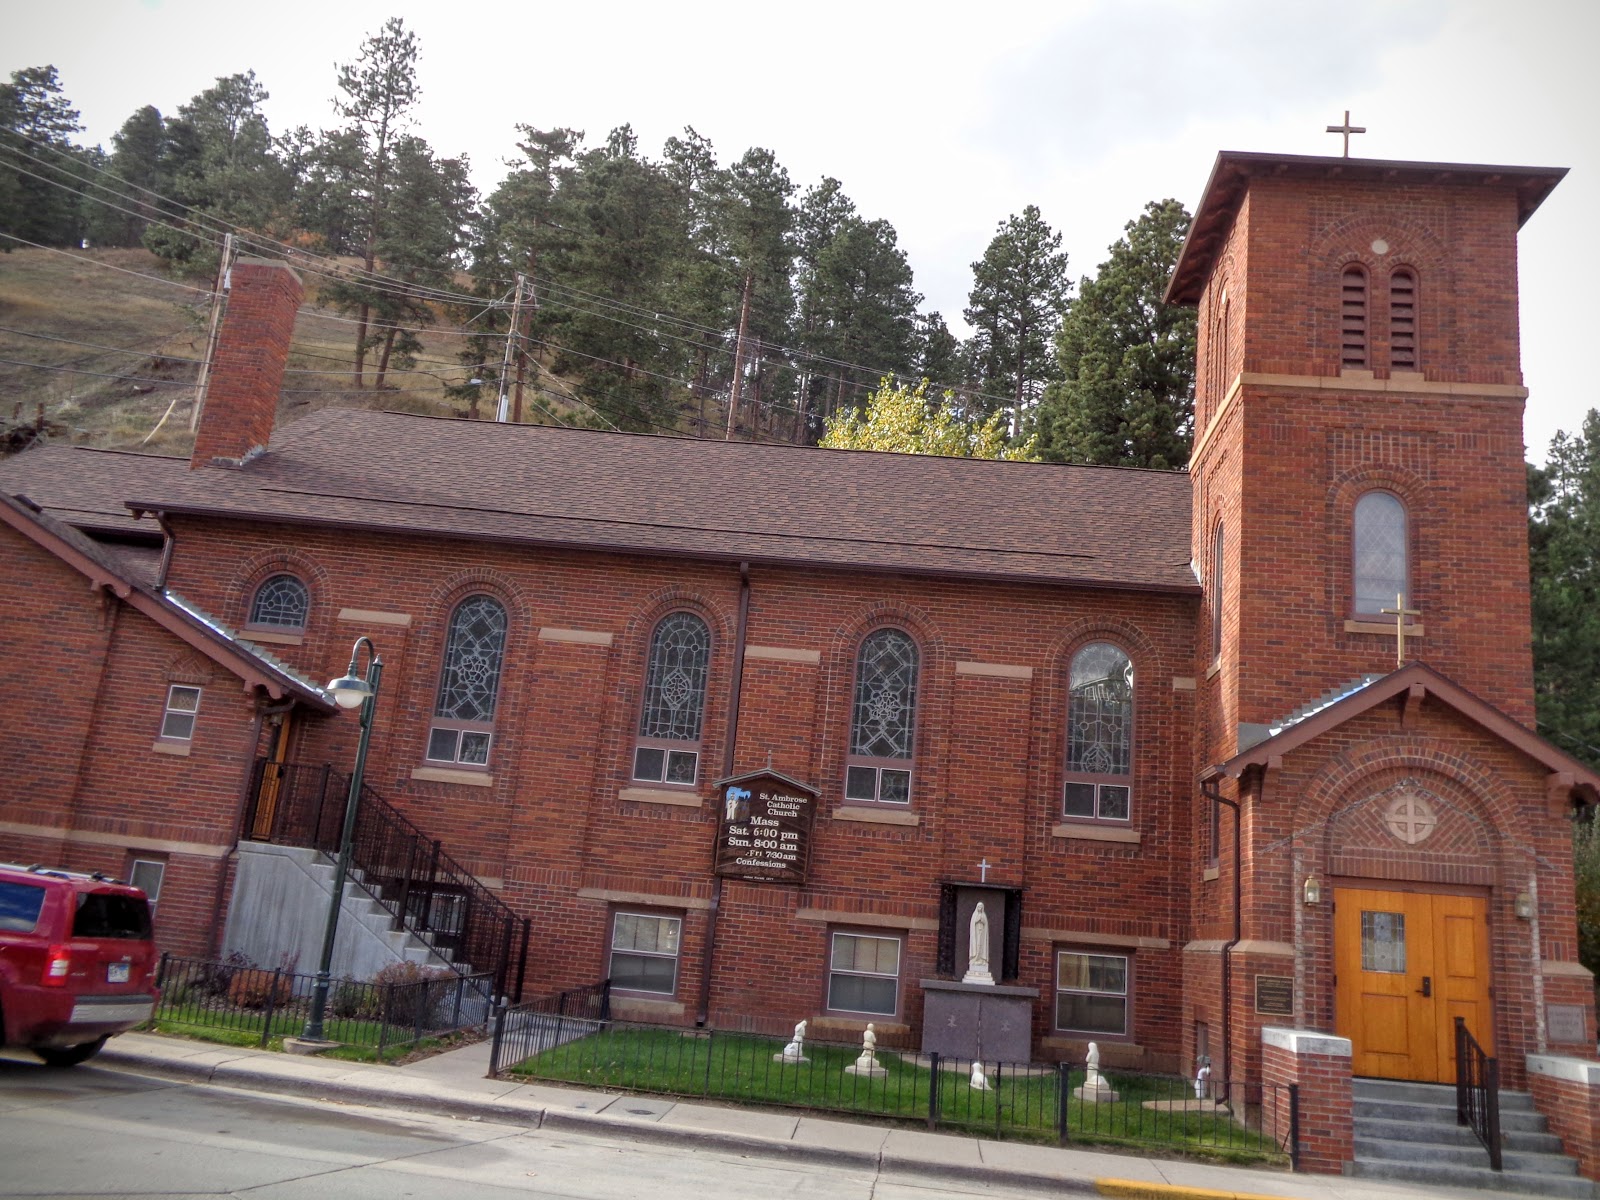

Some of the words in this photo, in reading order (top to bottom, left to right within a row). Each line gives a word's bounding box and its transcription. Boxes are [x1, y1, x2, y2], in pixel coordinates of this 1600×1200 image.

[759, 792, 770, 800] St.
[771, 794, 808, 804] Ambrose
[766, 800, 800, 810] Catholic
[767, 808, 798, 818] Church
[750, 816, 780, 827] Mass
[728, 825, 749, 836] Sat.
[753, 827, 778, 838] 6:00
[780, 831, 799, 841] pm
[727, 836, 752, 847] Sun.
[753, 838, 778, 849] 8:00
[779, 843, 797, 851] am
[735, 857, 787, 869] Confessions
